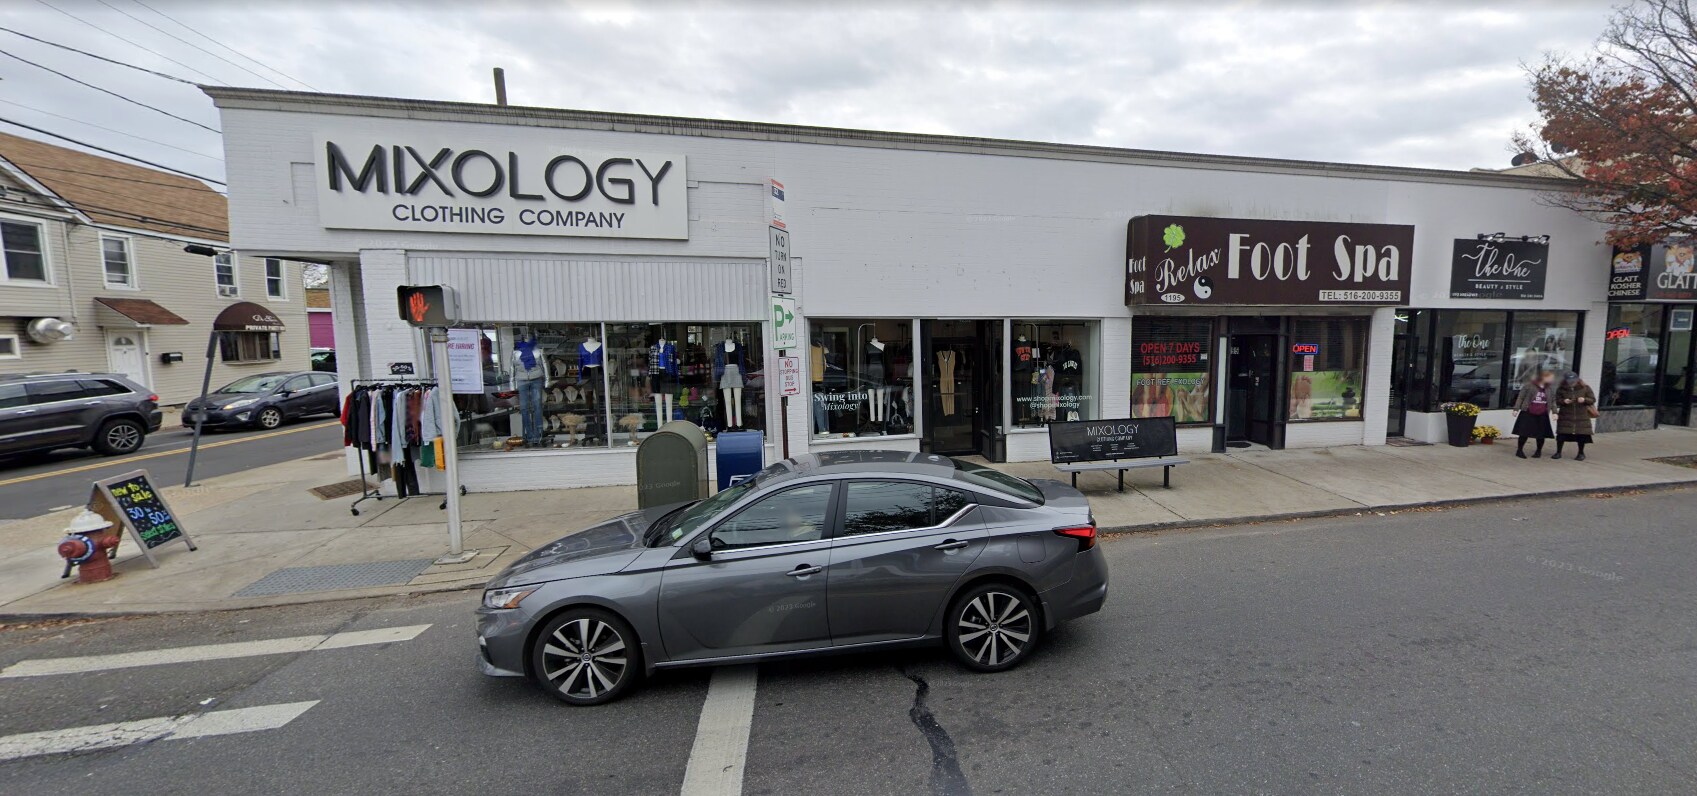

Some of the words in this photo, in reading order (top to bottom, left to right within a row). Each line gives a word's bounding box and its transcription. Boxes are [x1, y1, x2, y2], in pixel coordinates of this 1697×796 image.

[326, 140, 672, 205] MIXOLOGY
[392, 204, 505, 224] CLOTHING
[519, 208, 625, 229] COMPANY
[776, 234, 785, 248] NO
[774, 250, 787, 262] TURN
[1227, 233, 1311, 281] Foot
[1332, 234, 1400, 283] Spa
[1461, 242, 1501, 277] The
[1502, 253, 1542, 277] One
[777, 264, 785, 274] ON
[1129, 256, 1146, 273] Foot
[1154, 248, 1221, 293] Relax
[777, 278, 787, 289] RED
[1129, 279, 1145, 295] Spa
[1610, 282, 1642, 290] KOSHER
[1321, 291, 1342, 300] TEL:
[1343, 291, 1399, 300] 516-200-9355
[1458, 334, 1472, 349] The
[1472, 334, 1489, 349] One
[1140, 342, 1167, 354] OPEN
[1168, 342, 1174, 353] 7
[1175, 342, 1200, 353] DAYS
[1292, 344, 1317, 353] OPEN
[784, 360, 793, 368] NO
[1136, 378, 1155, 386] FOOT
[1156, 378, 1205, 386] REFEXOLOGY
[814, 392, 846, 402] Swing
[848, 391, 868, 400] into
[1016, 393, 1093, 403] www.shopmixology.com
[1086, 424, 1140, 437] MIXOLOGY
[126, 506, 145, 519] 30
